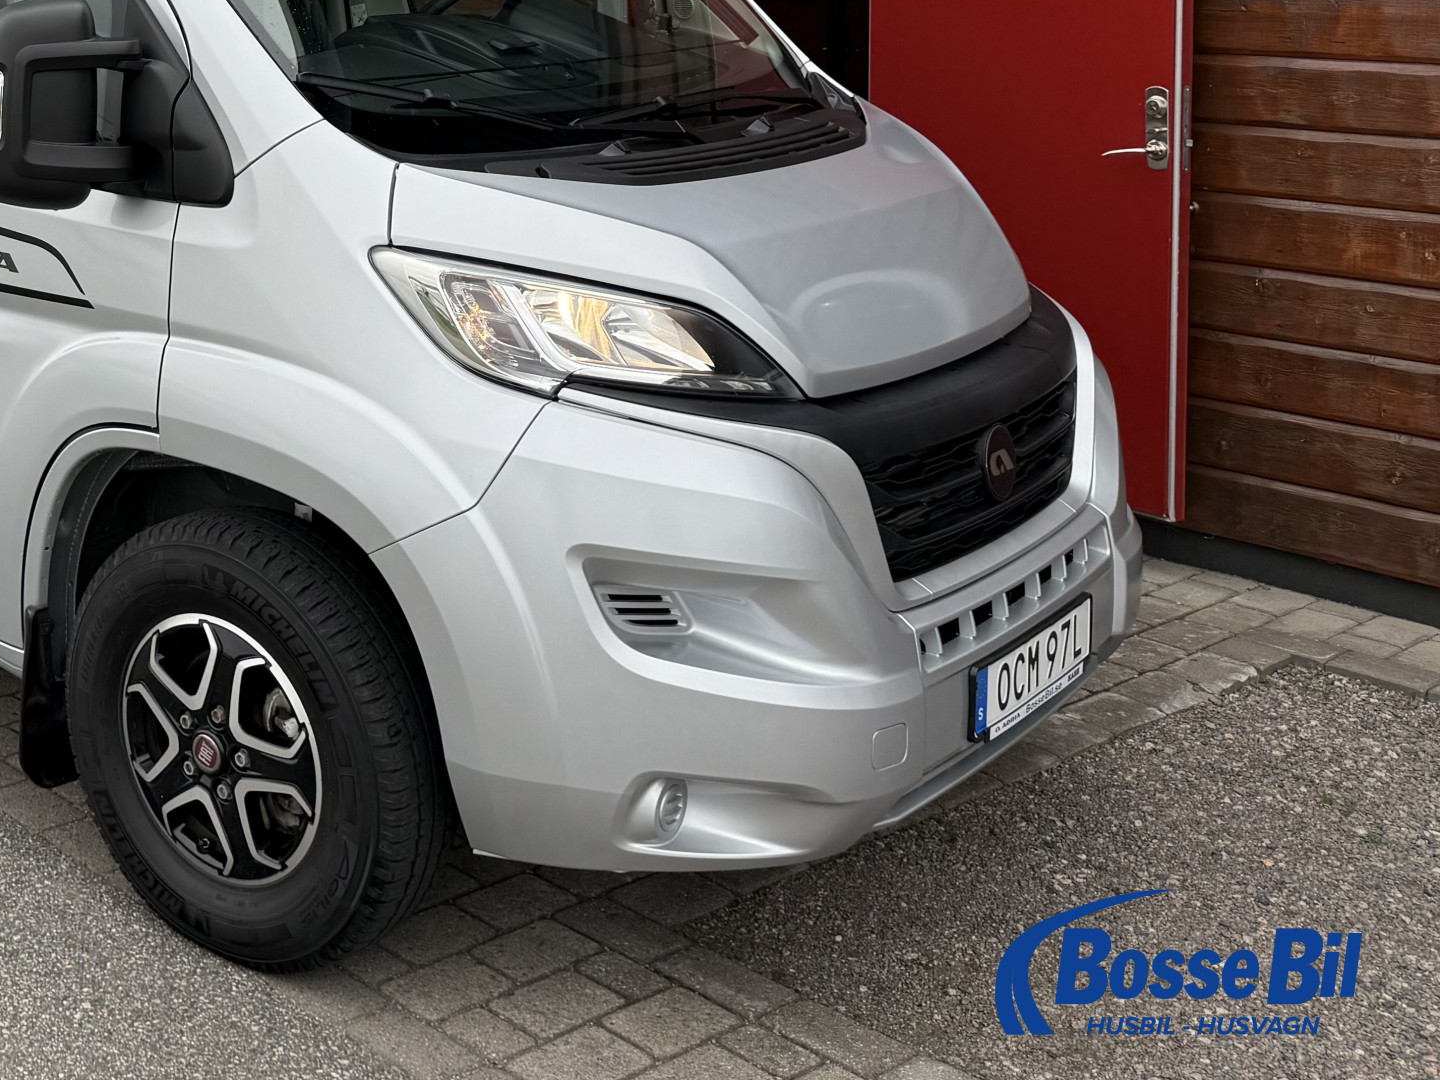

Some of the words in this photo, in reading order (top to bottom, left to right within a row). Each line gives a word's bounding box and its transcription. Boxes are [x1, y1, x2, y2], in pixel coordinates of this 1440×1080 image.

[229, 580, 339, 705] MICHELIN
[997, 640, 1040, 711] OCM
[1046, 614, 1082, 680] 97L
[977, 707, 984, 721] S
[198, 740, 215, 767] FIAT
